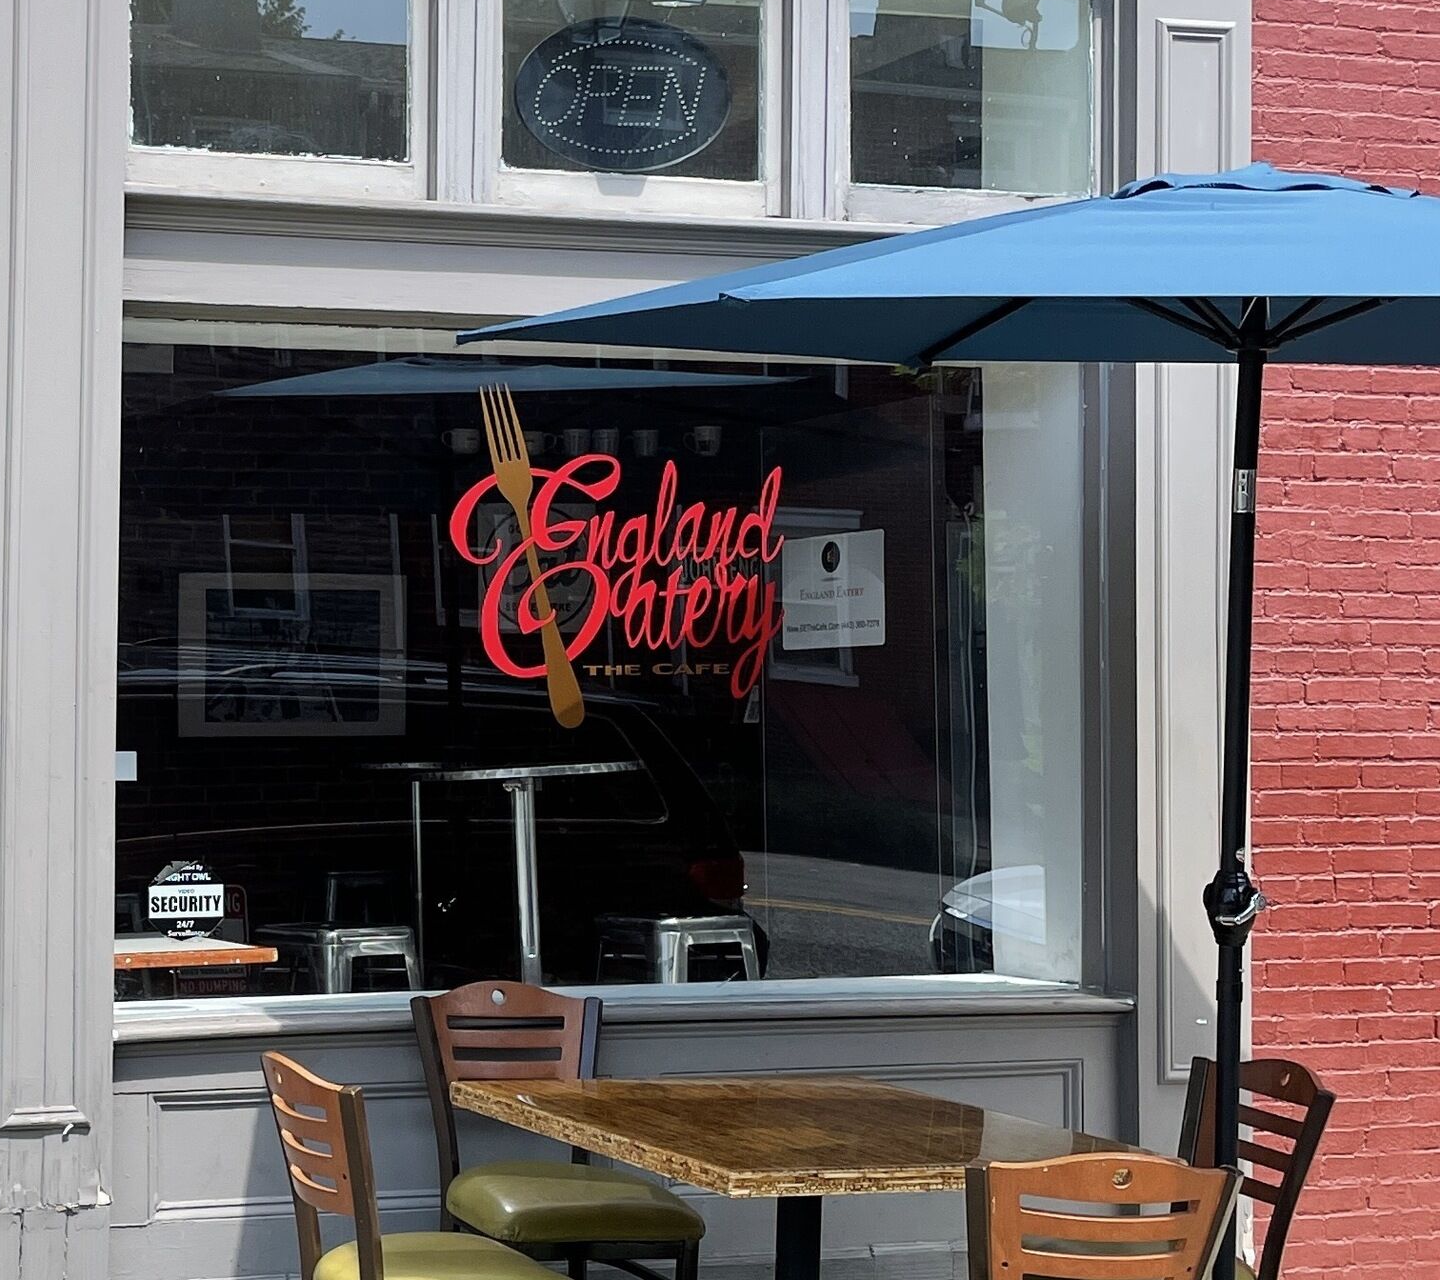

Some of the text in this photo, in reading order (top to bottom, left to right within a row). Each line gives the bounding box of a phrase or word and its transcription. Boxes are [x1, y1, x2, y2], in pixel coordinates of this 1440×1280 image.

[534, 64, 707, 127] OPEN
[450, 454, 784, 616] England
[481, 536, 784, 699] Eatery
[583, 663, 730, 676] THE CAFE
[192, 872, 212, 881] OWL
[150, 895, 222, 914] SECURITY
[176, 920, 195, 929] 24/7
